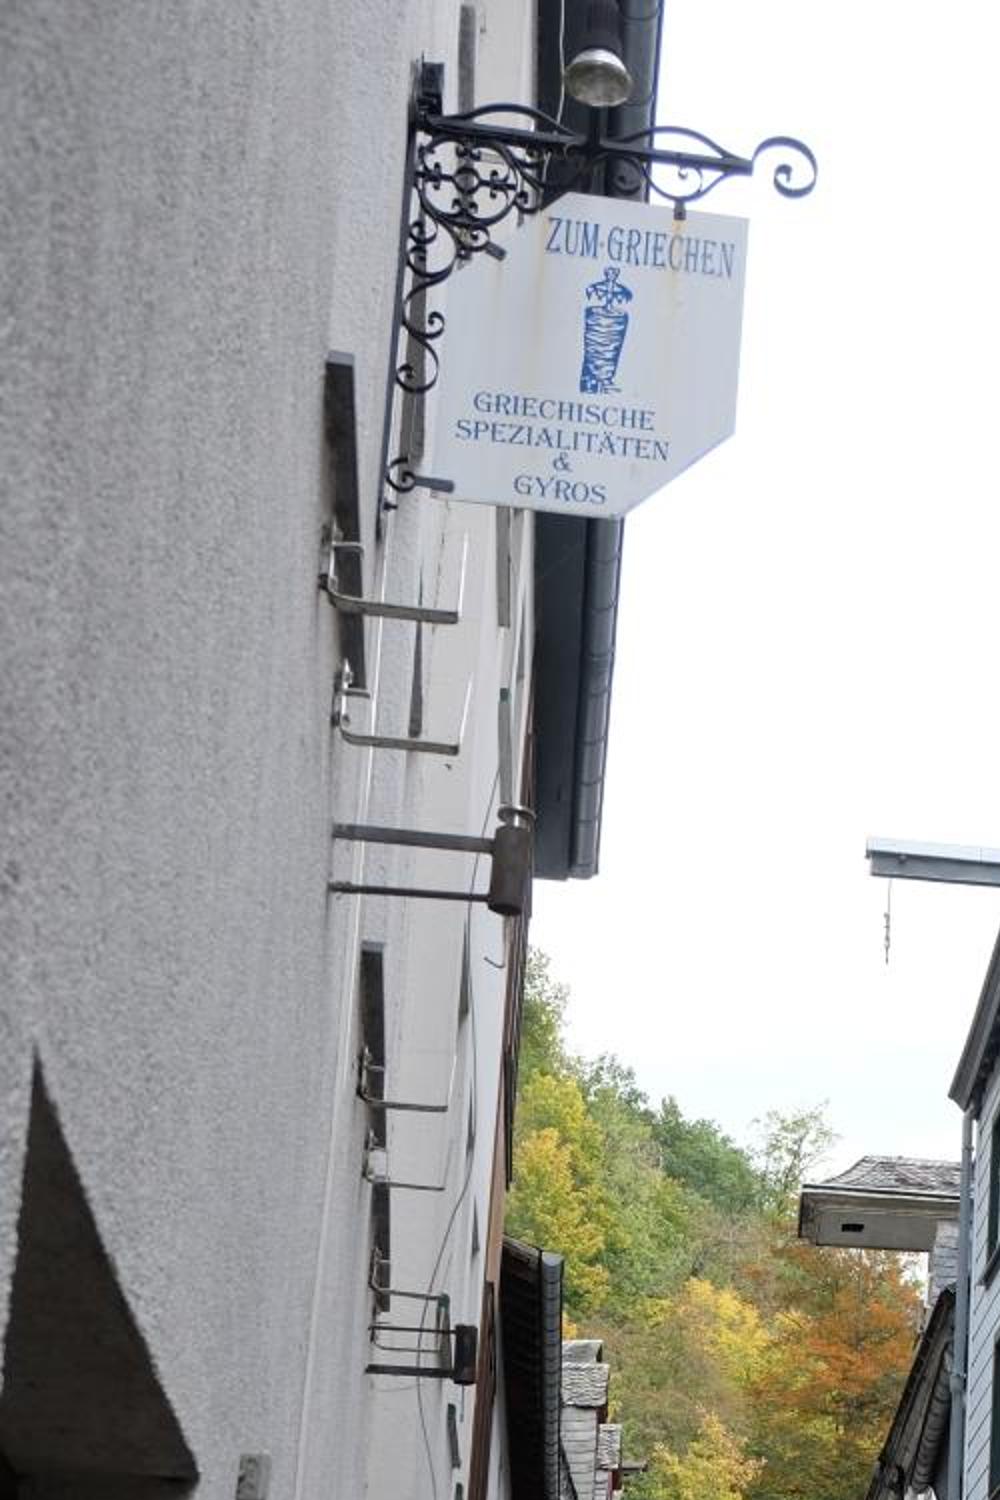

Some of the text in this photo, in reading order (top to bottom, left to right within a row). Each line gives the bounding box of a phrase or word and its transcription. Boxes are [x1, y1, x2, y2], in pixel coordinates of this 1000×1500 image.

[545, 217, 736, 279] ZUM GRIECHEN
[473, 391, 656, 431] GRIECHISCHE
[455, 419, 670, 461] SPEZIALITÄTEN
[552, 452, 573, 473] &
[513, 475, 607, 505] GYROS
